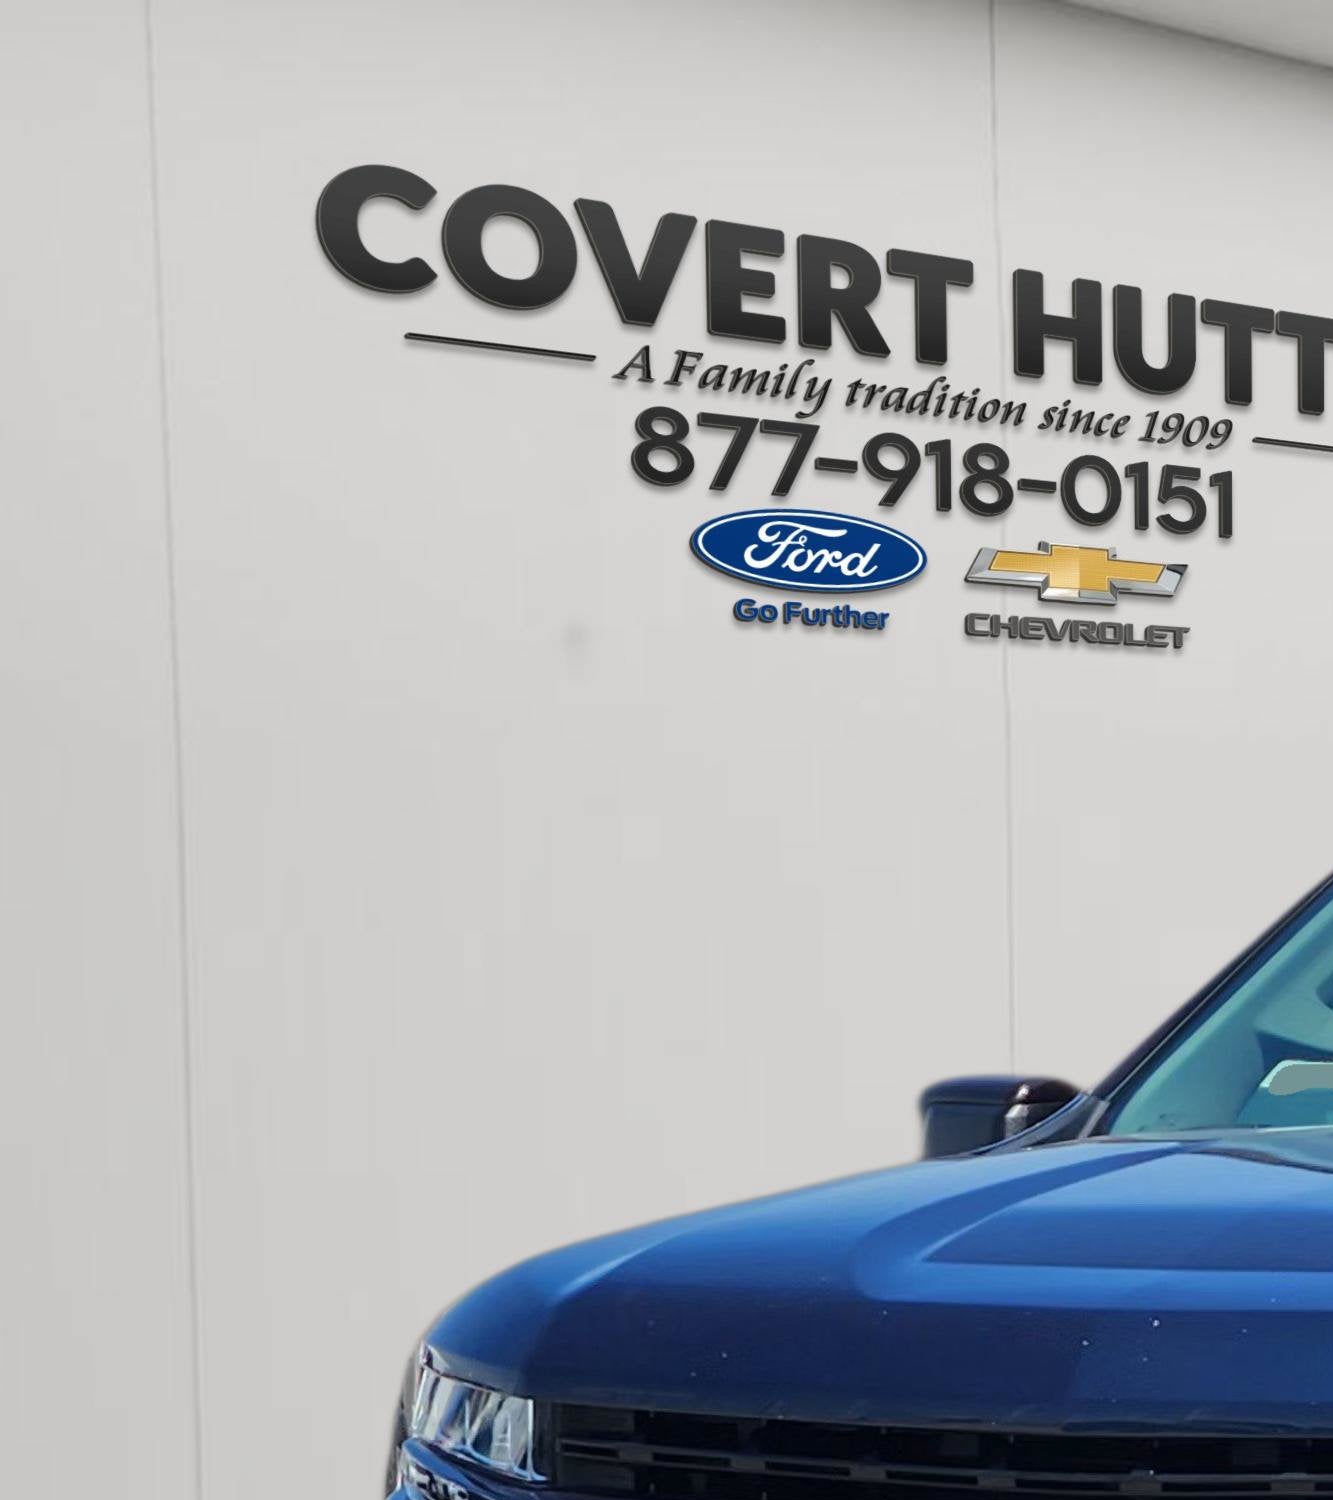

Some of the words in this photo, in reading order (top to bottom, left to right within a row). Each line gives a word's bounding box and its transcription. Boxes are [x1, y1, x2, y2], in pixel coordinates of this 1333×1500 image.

[316, 164, 973, 366] COVERT
[611, 344, 655, 384] A
[664, 349, 833, 419] Family
[844, 375, 1028, 426] tradition
[1037, 399, 1132, 439] since
[1137, 409, 1234, 450] 1909
[630, 405, 1233, 539] 877-918-0151
[743, 520, 882, 578] Ford
[732, 597, 779, 623] Go
[783, 601, 890, 631] Further
[964, 612, 1191, 649] CHEVROLET
